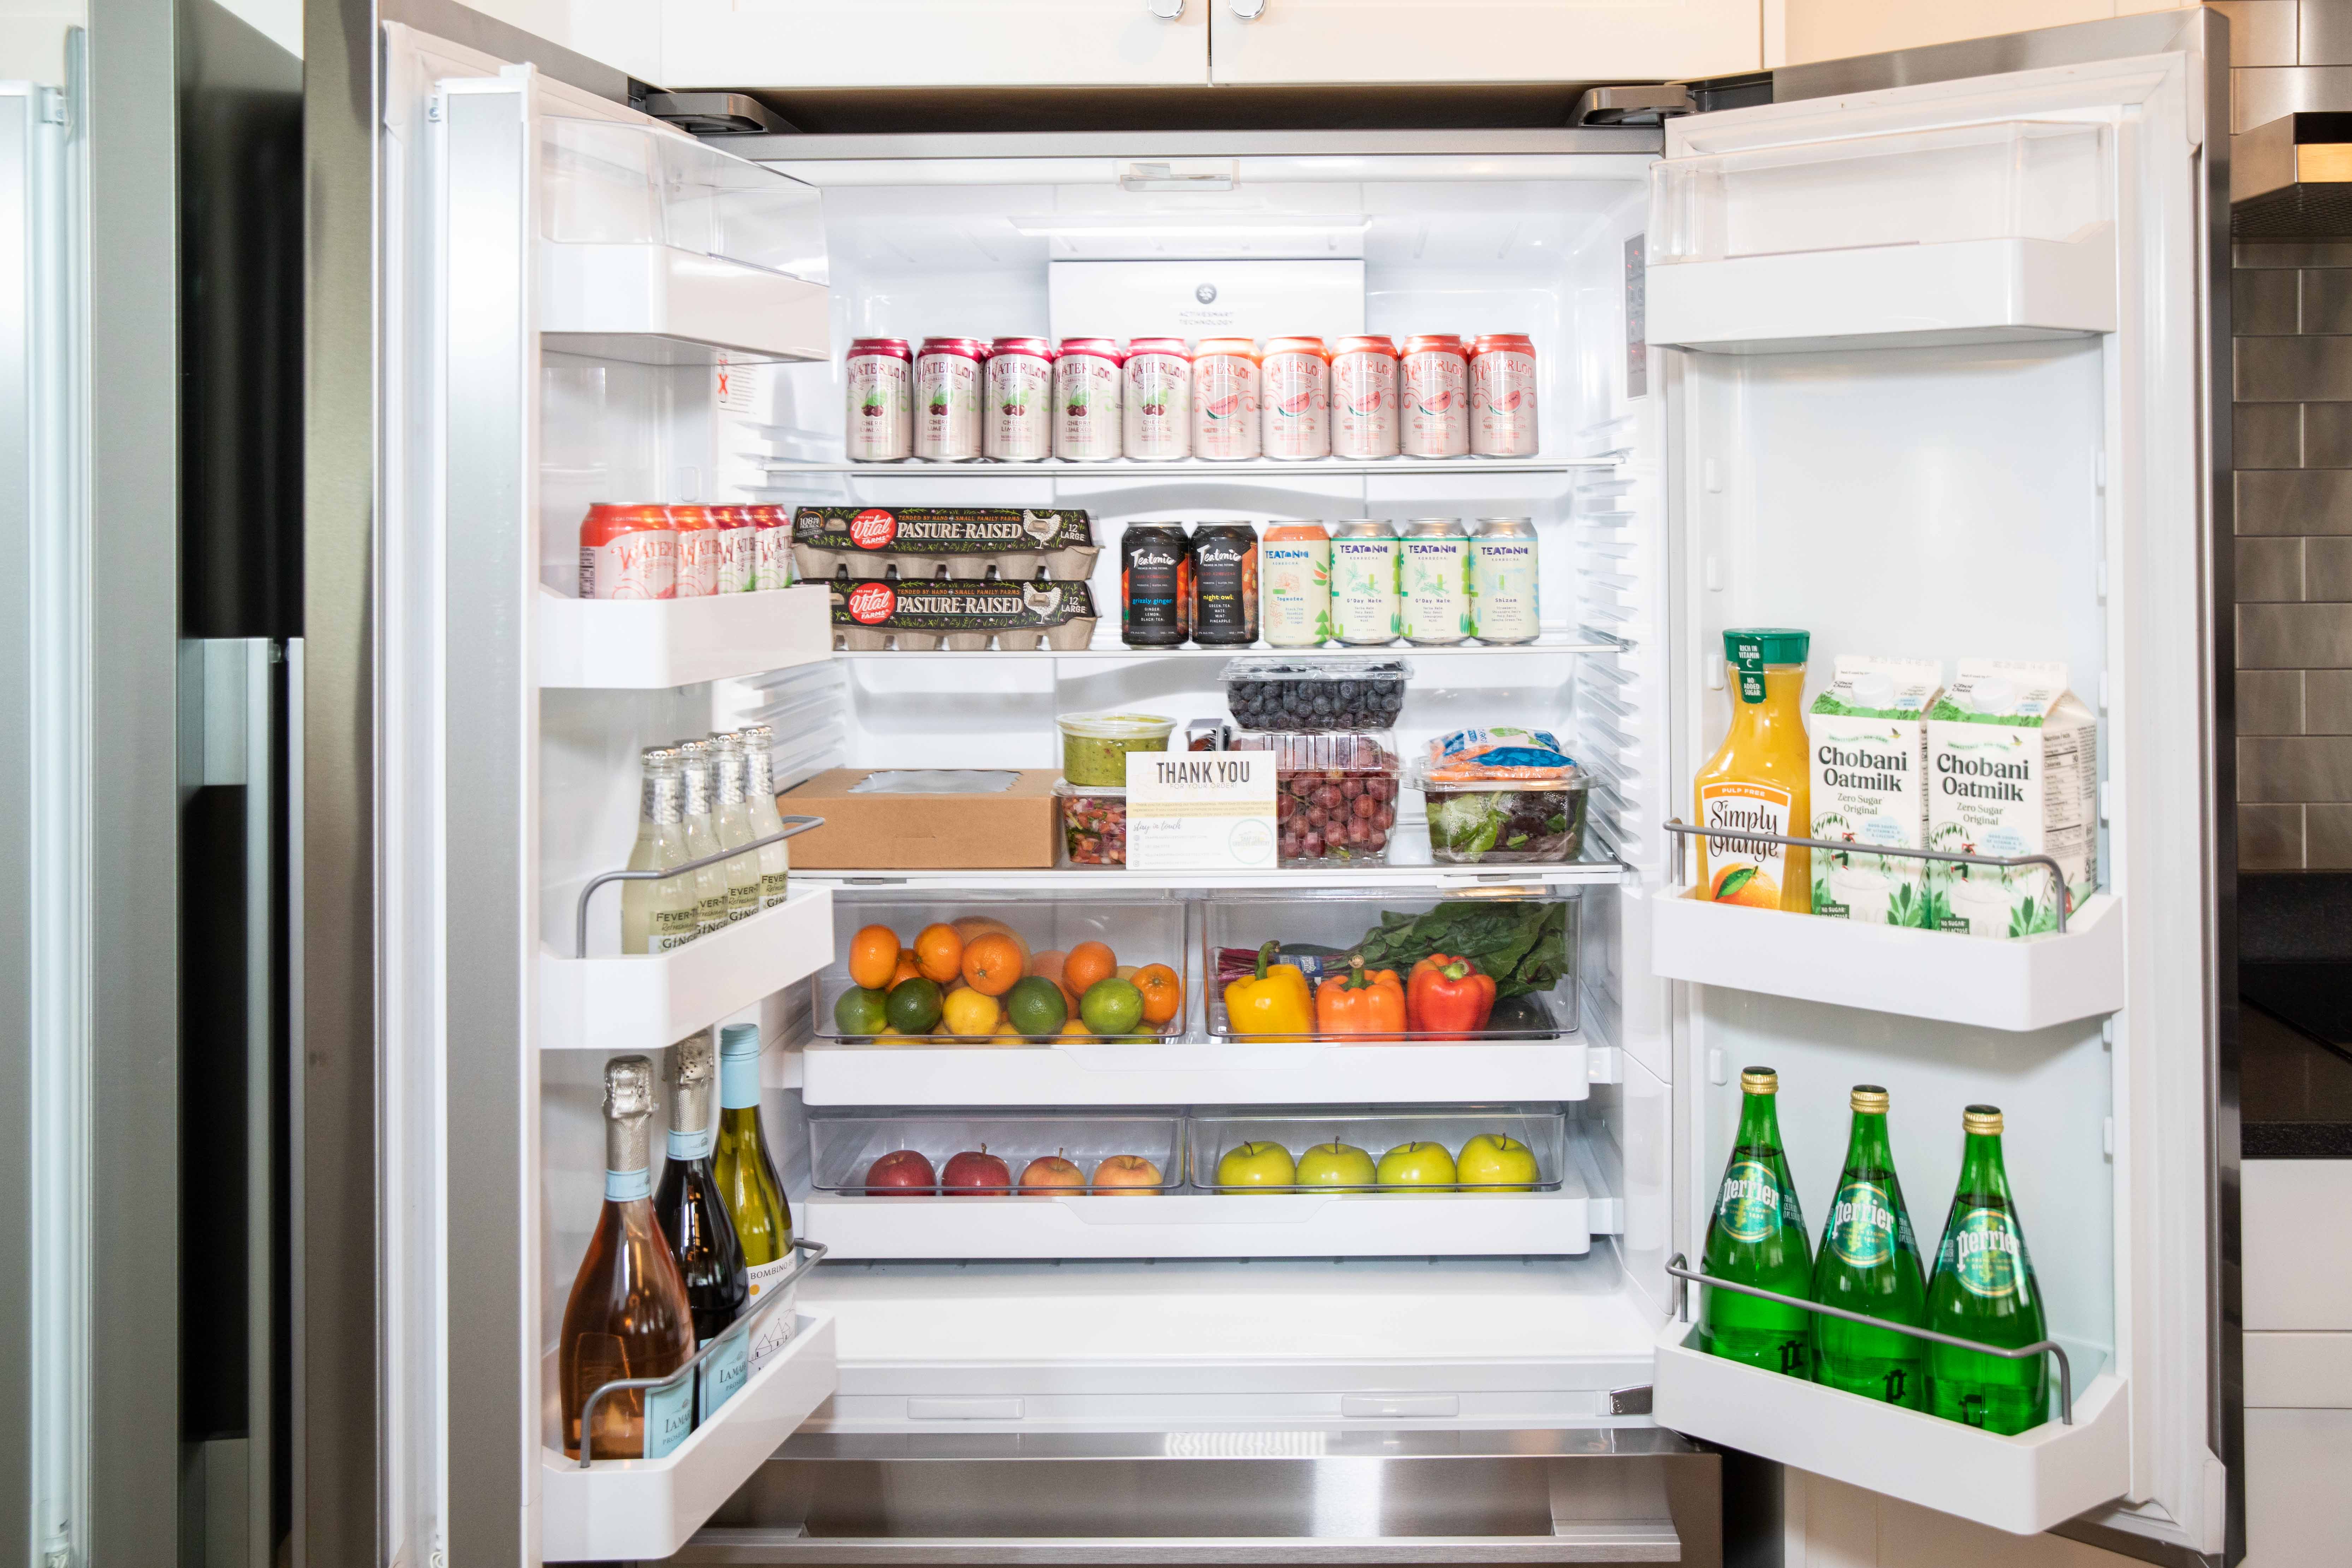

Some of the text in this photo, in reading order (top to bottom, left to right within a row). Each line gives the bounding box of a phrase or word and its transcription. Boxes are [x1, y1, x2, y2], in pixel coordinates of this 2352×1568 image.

[847, 359, 906, 383] WATERLOO
[800, 517, 812, 525] 108
[851, 515, 892, 539] Vital
[1069, 524, 1078, 533] 12
[896, 522, 1023, 539] PASTURE-RAISED
[1060, 531, 1085, 541] LARGE
[1197, 544, 1241, 565] Teatonic
[1265, 550, 1308, 559] TEATONIC
[1340, 545, 1388, 553] TEATONIC
[1408, 545, 1456, 553] TEATONIC
[1481, 547, 1528, 555] TEATONIC
[1130, 548, 1176, 568] Teatonic
[850, 588, 890, 613] Vital
[896, 596, 1023, 613] PASTURE-RAISED
[1069, 596, 1079, 605] 12
[1061, 604, 1087, 614] LARGE
[1746, 659, 1752, 668] C
[1818, 746, 1907, 771] Chobani
[2073, 754, 2078, 762] 90
[1156, 761, 1249, 783] THANK YOU
[1937, 753, 2030, 780] Chobani
[1823, 768, 1902, 792] Oatmilk
[1744, 789, 1765, 797] FREE
[1942, 776, 2024, 802] Oatmilk
[1837, 793, 1856, 802] Zero
[1843, 804, 1877, 815] Original
[1957, 802, 1976, 812] Zero
[1710, 800, 1777, 833] Simply
[1963, 813, 1999, 826] Original
[1133, 821, 1151, 834] stay
[1160, 818, 1181, 830] touch
[761, 873, 786, 884] FEVER
[1720, 1177, 1779, 1216] perrier
[1832, 1199, 1895, 1240] perrier
[1956, 1225, 2020, 1273] perrier
[750, 1262, 788, 1279] BOMBINO
